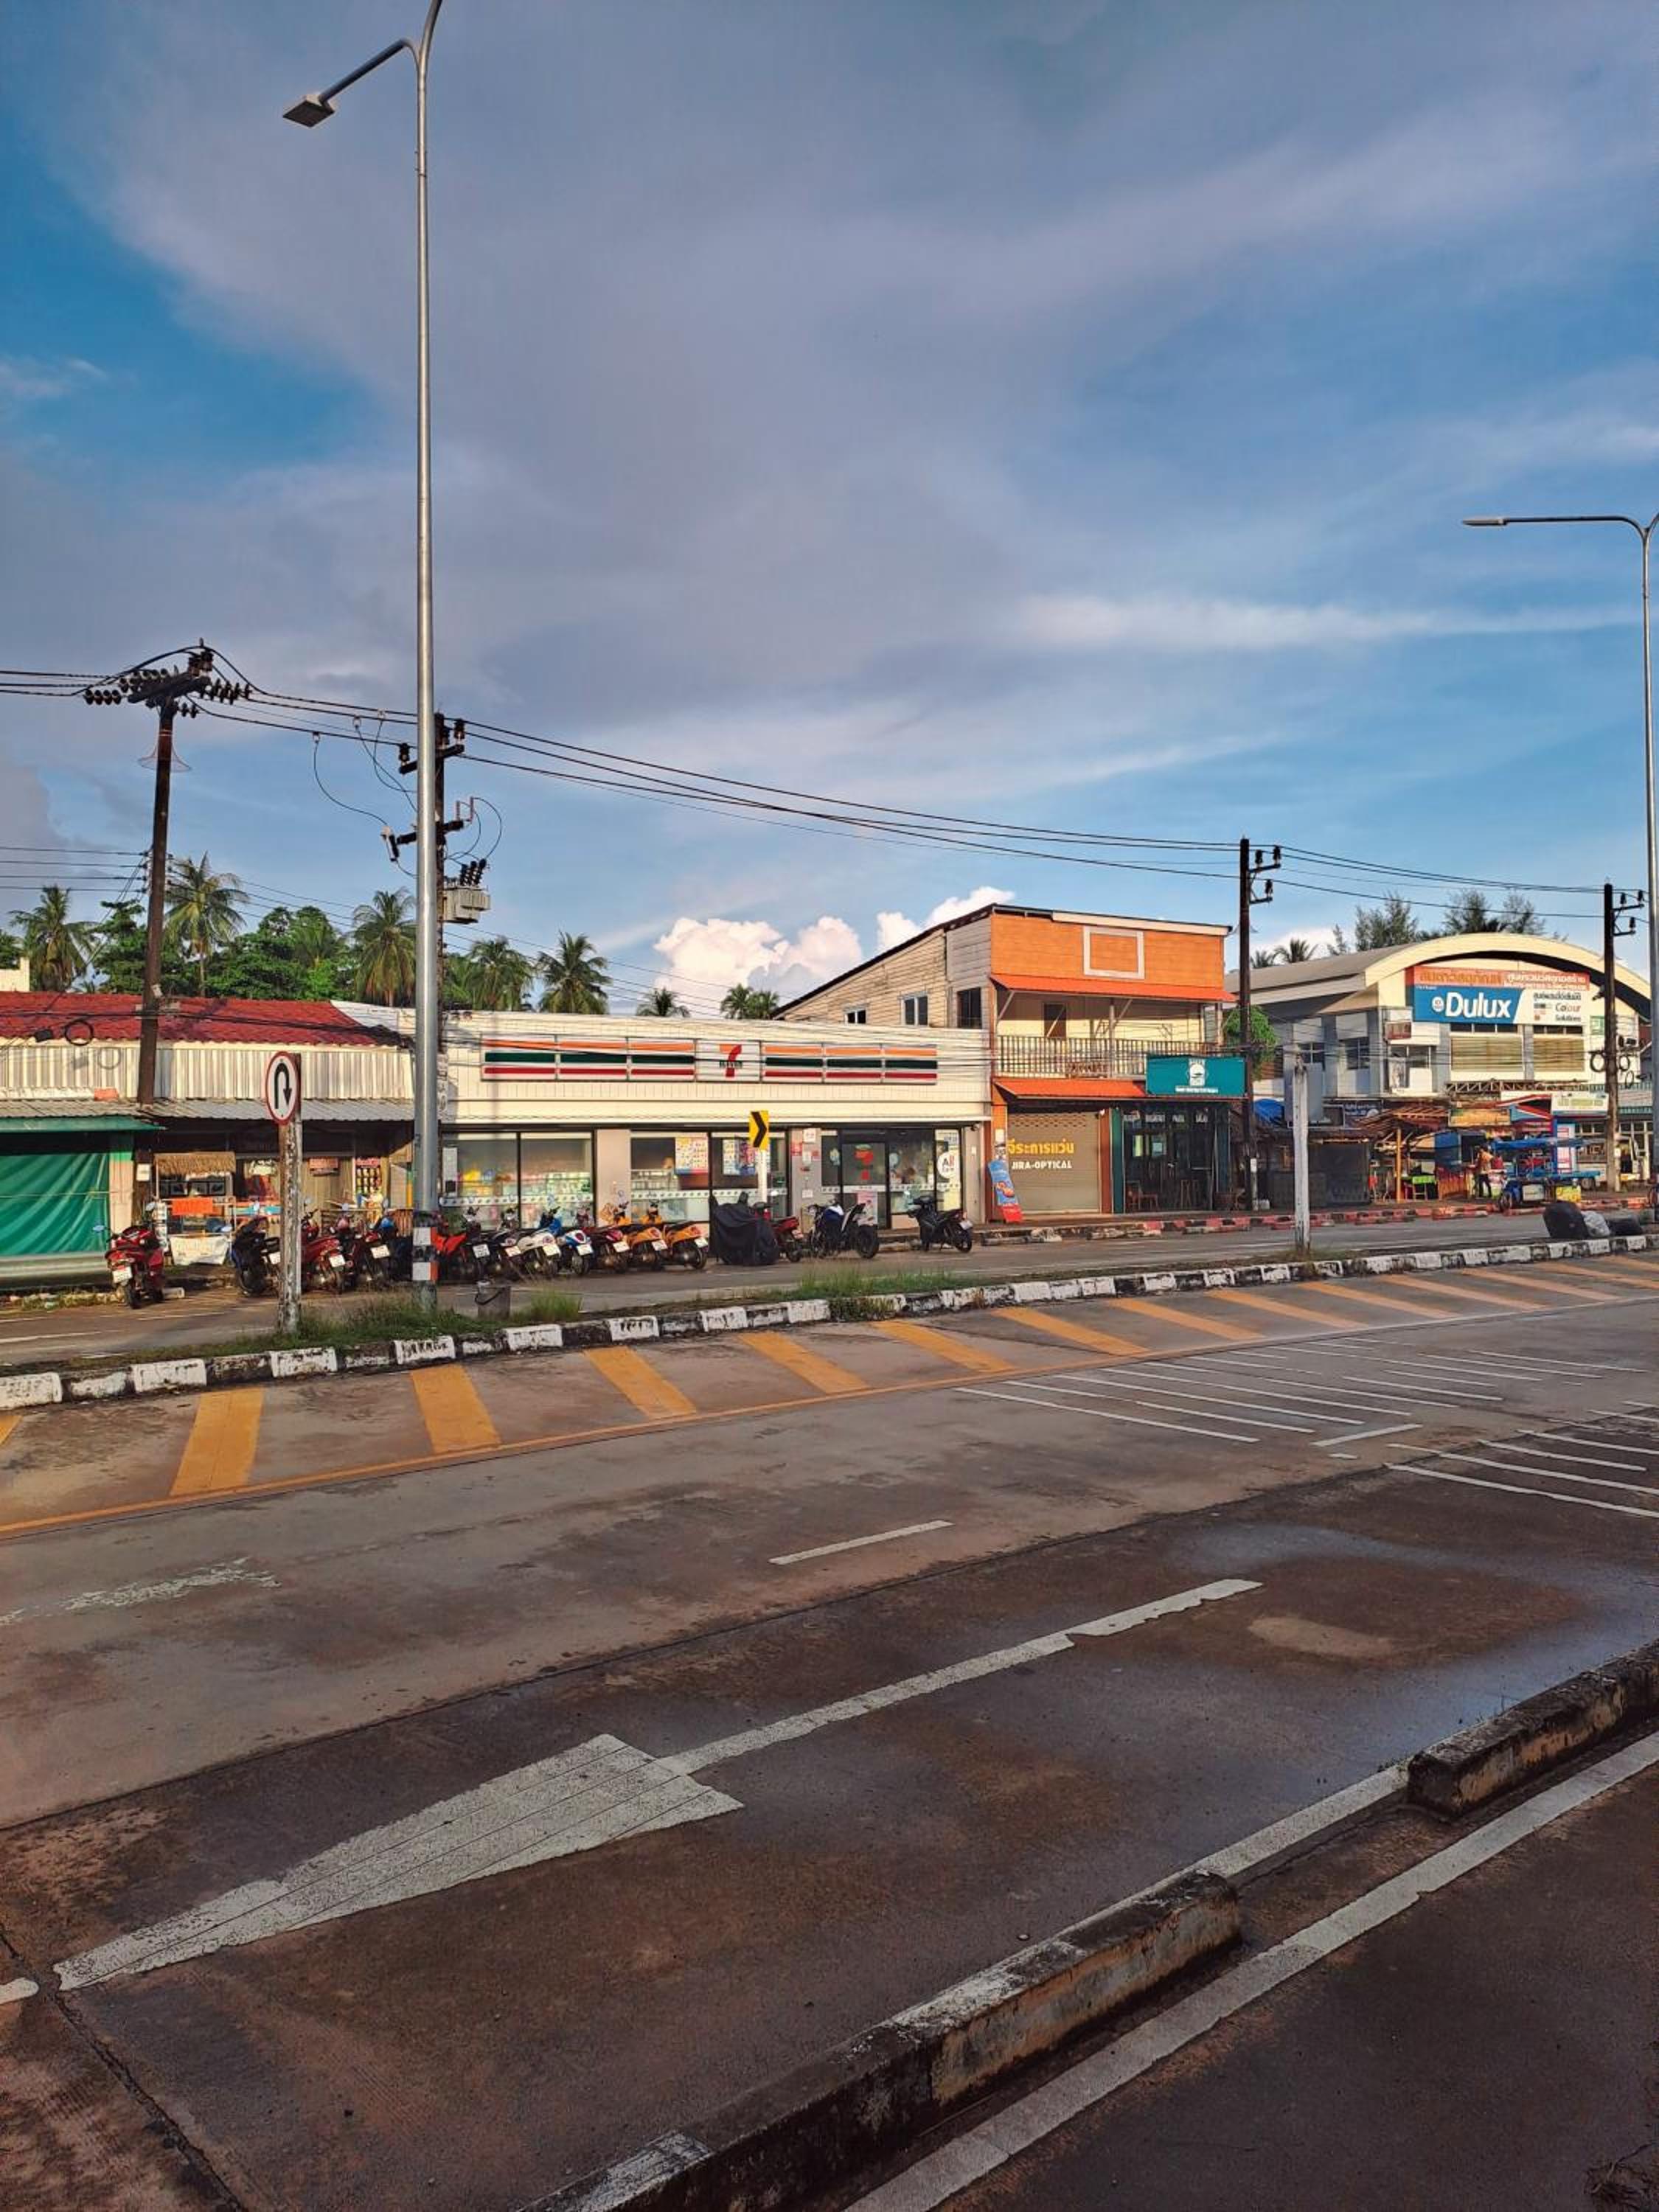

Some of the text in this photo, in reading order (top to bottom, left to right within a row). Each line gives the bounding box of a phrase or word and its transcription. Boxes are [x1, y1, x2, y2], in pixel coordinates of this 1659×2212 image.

[1446, 992, 1512, 1018] Dulux
[1007, 1138, 1074, 1155] จีระการแว่น
[1012, 1160, 1073, 1170] JIRA-OPTICAL
